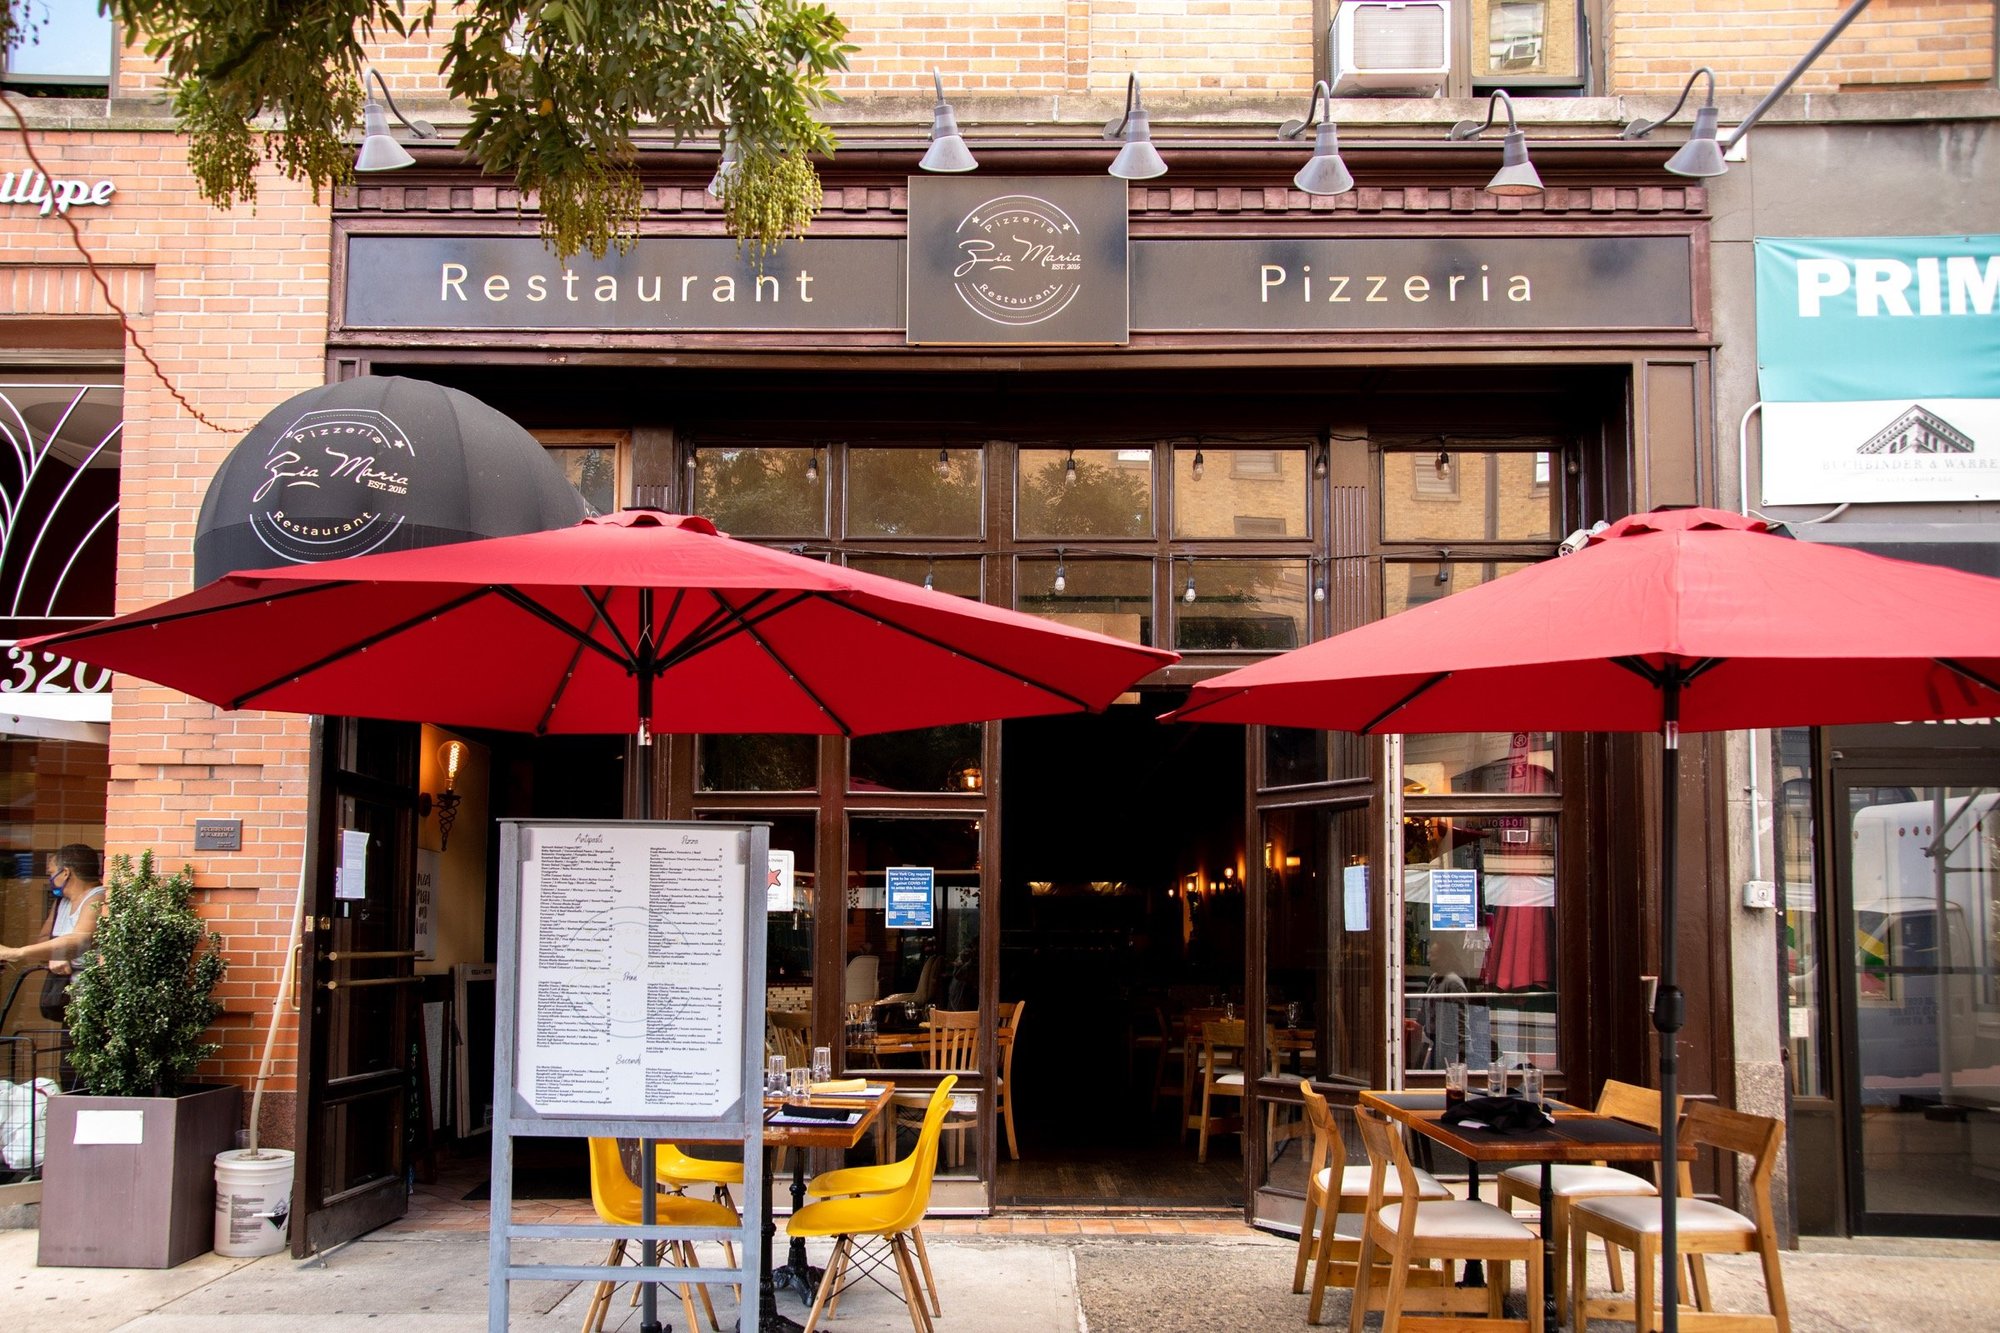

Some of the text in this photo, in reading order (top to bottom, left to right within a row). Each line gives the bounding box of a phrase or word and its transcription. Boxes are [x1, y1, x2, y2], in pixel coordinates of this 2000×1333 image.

[984, 216, 1055, 234] Pizzeria
[953, 234, 1082, 278] Zia Maria
[441, 263, 814, 302] Restaurant
[979, 283, 1058, 305] Restaurant
[1261, 264, 1532, 302] Pizzeria
[294, 427, 383, 444] Pizzeria
[252, 446, 409, 503] Zia Maria
[367, 480, 408, 495] EST. 2016
[273, 510, 372, 536] Restaurant
